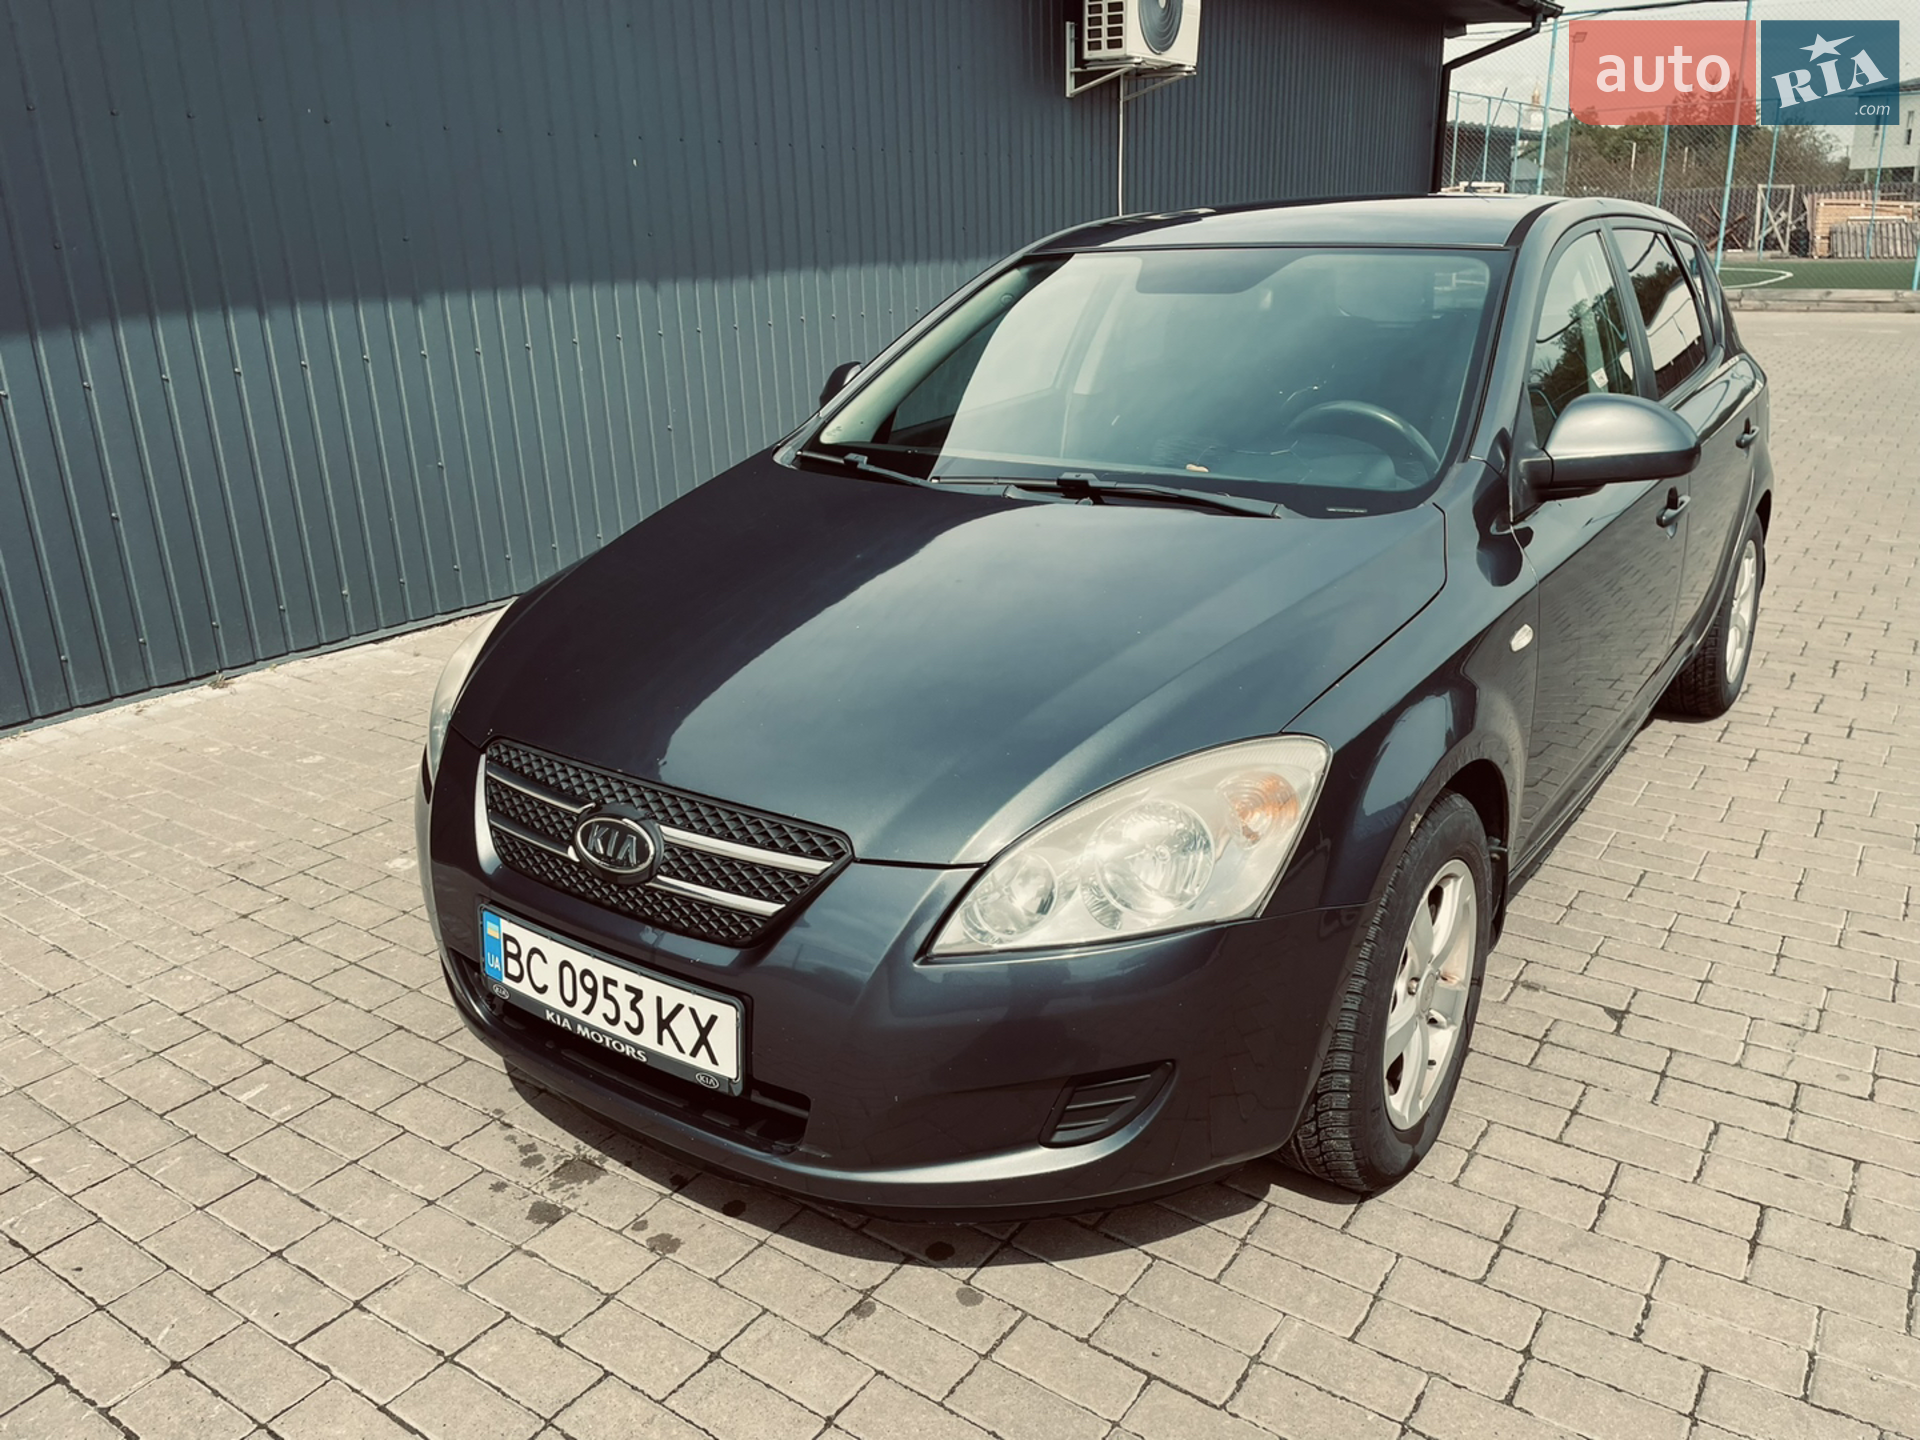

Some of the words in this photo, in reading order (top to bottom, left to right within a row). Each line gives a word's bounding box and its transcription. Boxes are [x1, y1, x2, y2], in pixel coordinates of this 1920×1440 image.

[587, 824, 637, 867] KIA
[487, 951, 501, 971] UA
[502, 931, 549, 995] BC
[558, 959, 645, 1036] 0953
[656, 995, 720, 1067] KX
[545, 1009, 572, 1032] KIA
[576, 1023, 648, 1063] MOTORS
